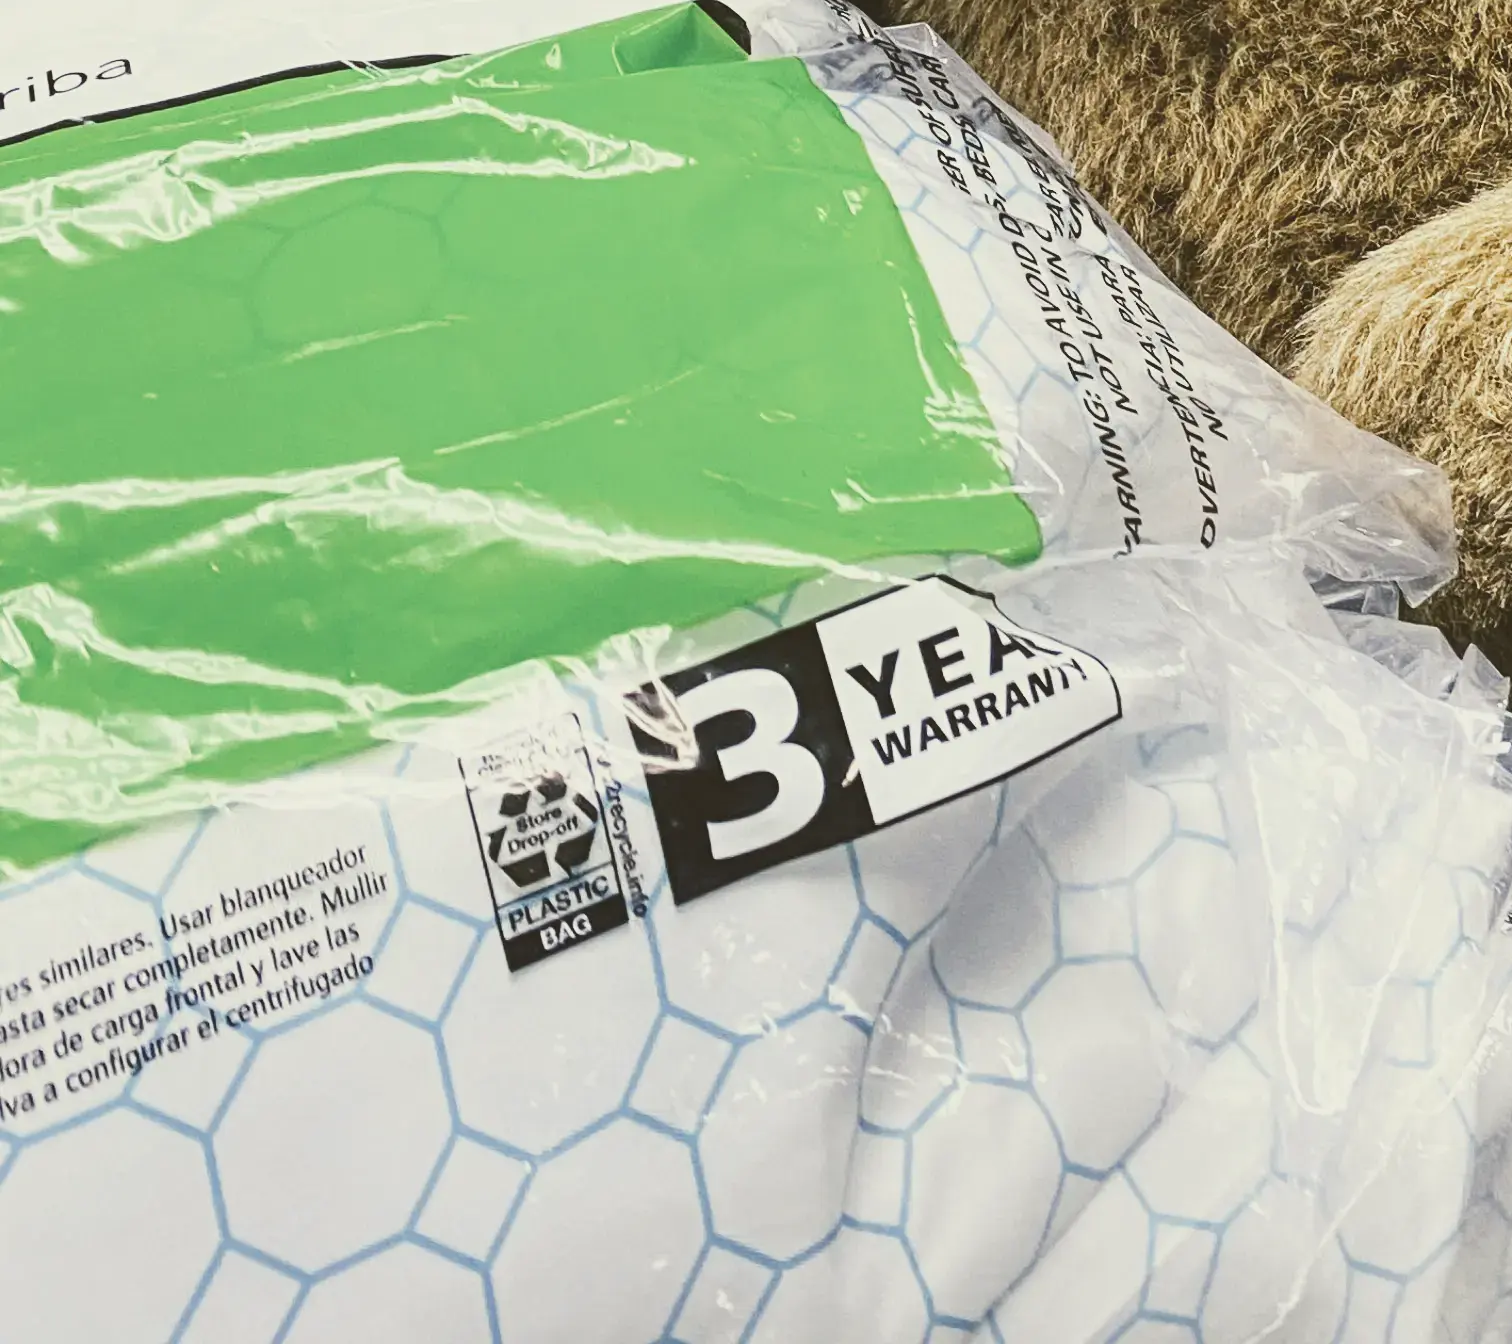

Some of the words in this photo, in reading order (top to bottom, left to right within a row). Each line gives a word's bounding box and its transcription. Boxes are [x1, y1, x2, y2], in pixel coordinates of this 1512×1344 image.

[1012, 241, 1075, 340] AVOID
[1041, 247, 1071, 283] IN
[1095, 254, 1142, 329] PARA
[1057, 283, 1103, 341] USE
[1121, 264, 1194, 392] UTILIZAR
[1060, 341, 1094, 383] TO
[1090, 343, 1138, 415] NOT
[1189, 396, 1228, 441] NO
[675, 667, 826, 861] 3
[507, 815, 578, 855] Drop-off
[516, 807, 563, 832] Store
[0, 977, 32, 1006] es
[39, 930, 154, 989] similares.
[159, 903, 214, 941] Usar
[220, 844, 367, 917] blanqueador
[508, 875, 609, 932] PLASTIC
[539, 913, 592, 951] BAG
[53, 980, 117, 1023] secar
[124, 904, 315, 993] completamente.
[320, 870, 388, 919] Mullir
[54, 1028, 83, 1059] de
[92, 1002, 159, 1045] carga
[165, 961, 245, 1014] frontal
[251, 959, 265, 986] y
[271, 939, 320, 974] lave
[327, 921, 361, 951] las
[43, 1081, 58, 1103] a
[65, 1030, 190, 1095] configurar
[198, 1011, 219, 1041] el
[225, 952, 374, 1029] centrifugado
